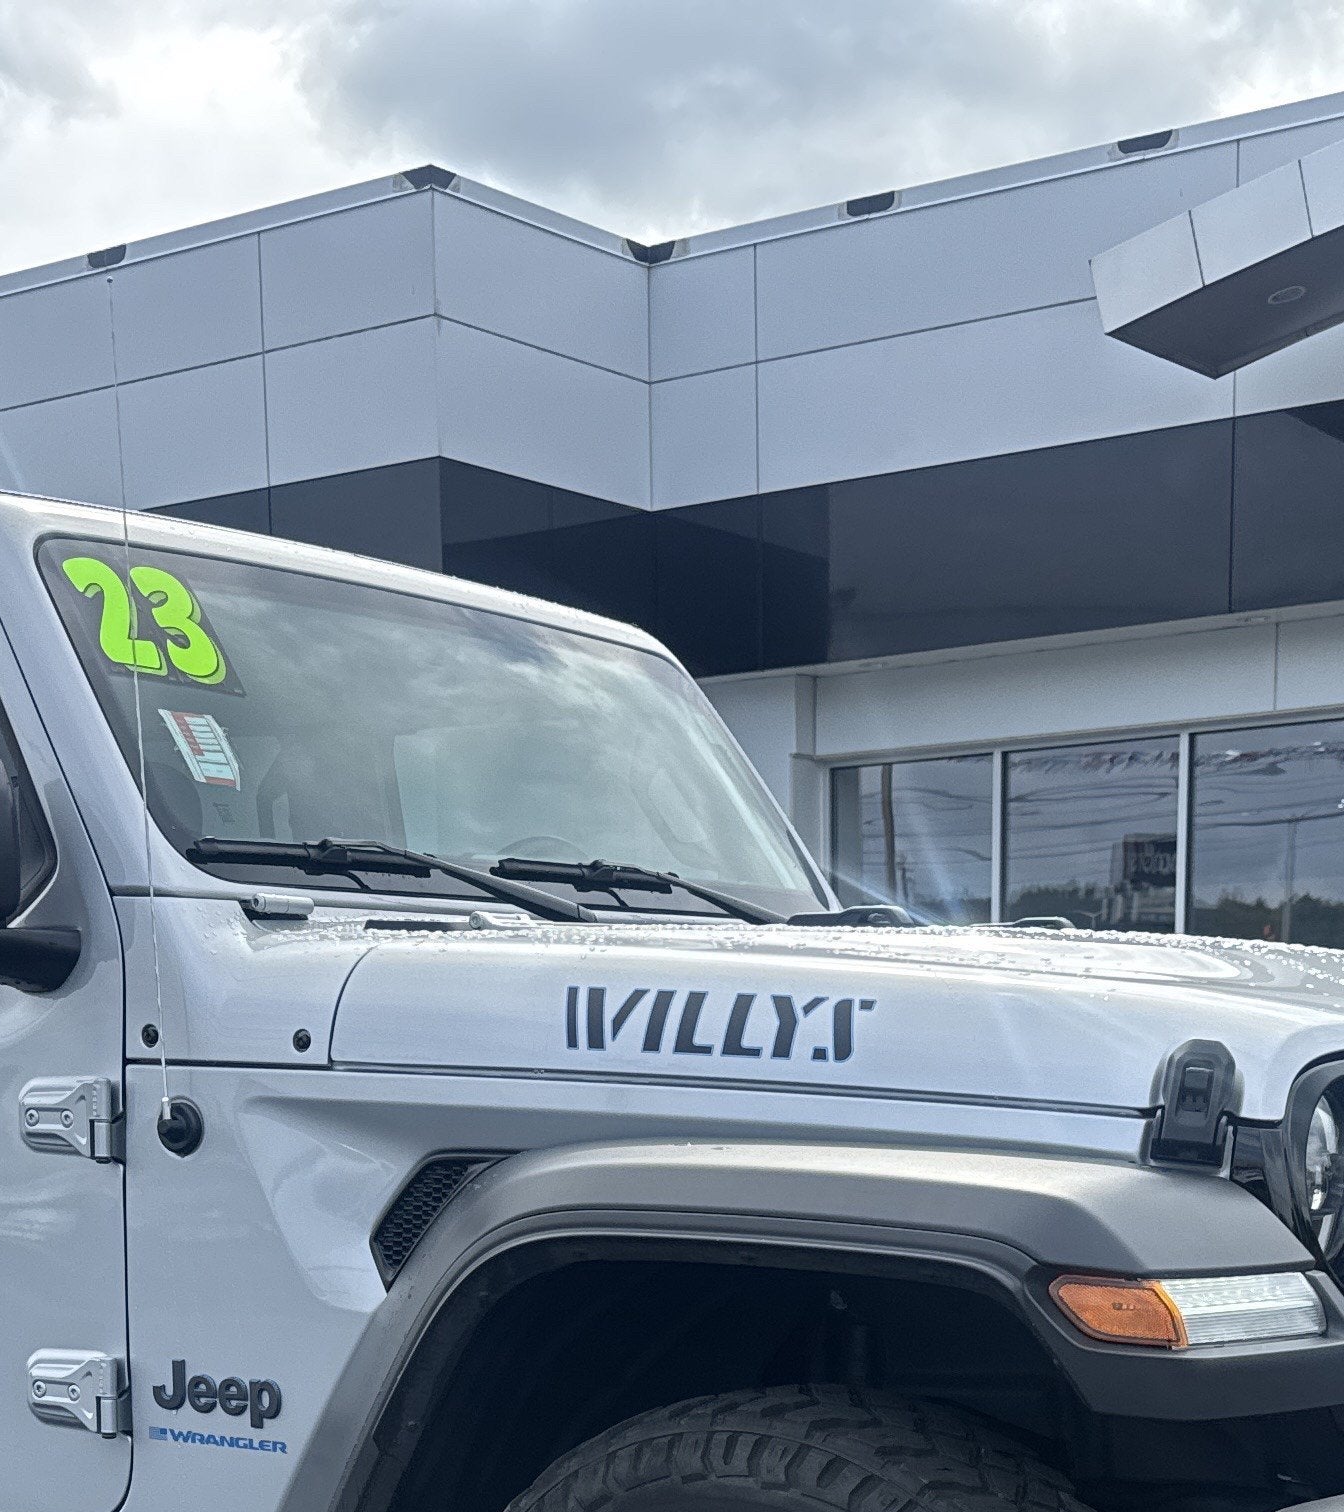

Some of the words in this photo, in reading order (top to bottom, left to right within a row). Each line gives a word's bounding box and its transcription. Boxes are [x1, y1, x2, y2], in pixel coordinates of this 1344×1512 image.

[62, 557, 227, 685] 23
[566, 986, 877, 1063] WILLYS
[152, 1359, 282, 1429] Jeep
[168, 1428, 288, 1454] WRANGLER
